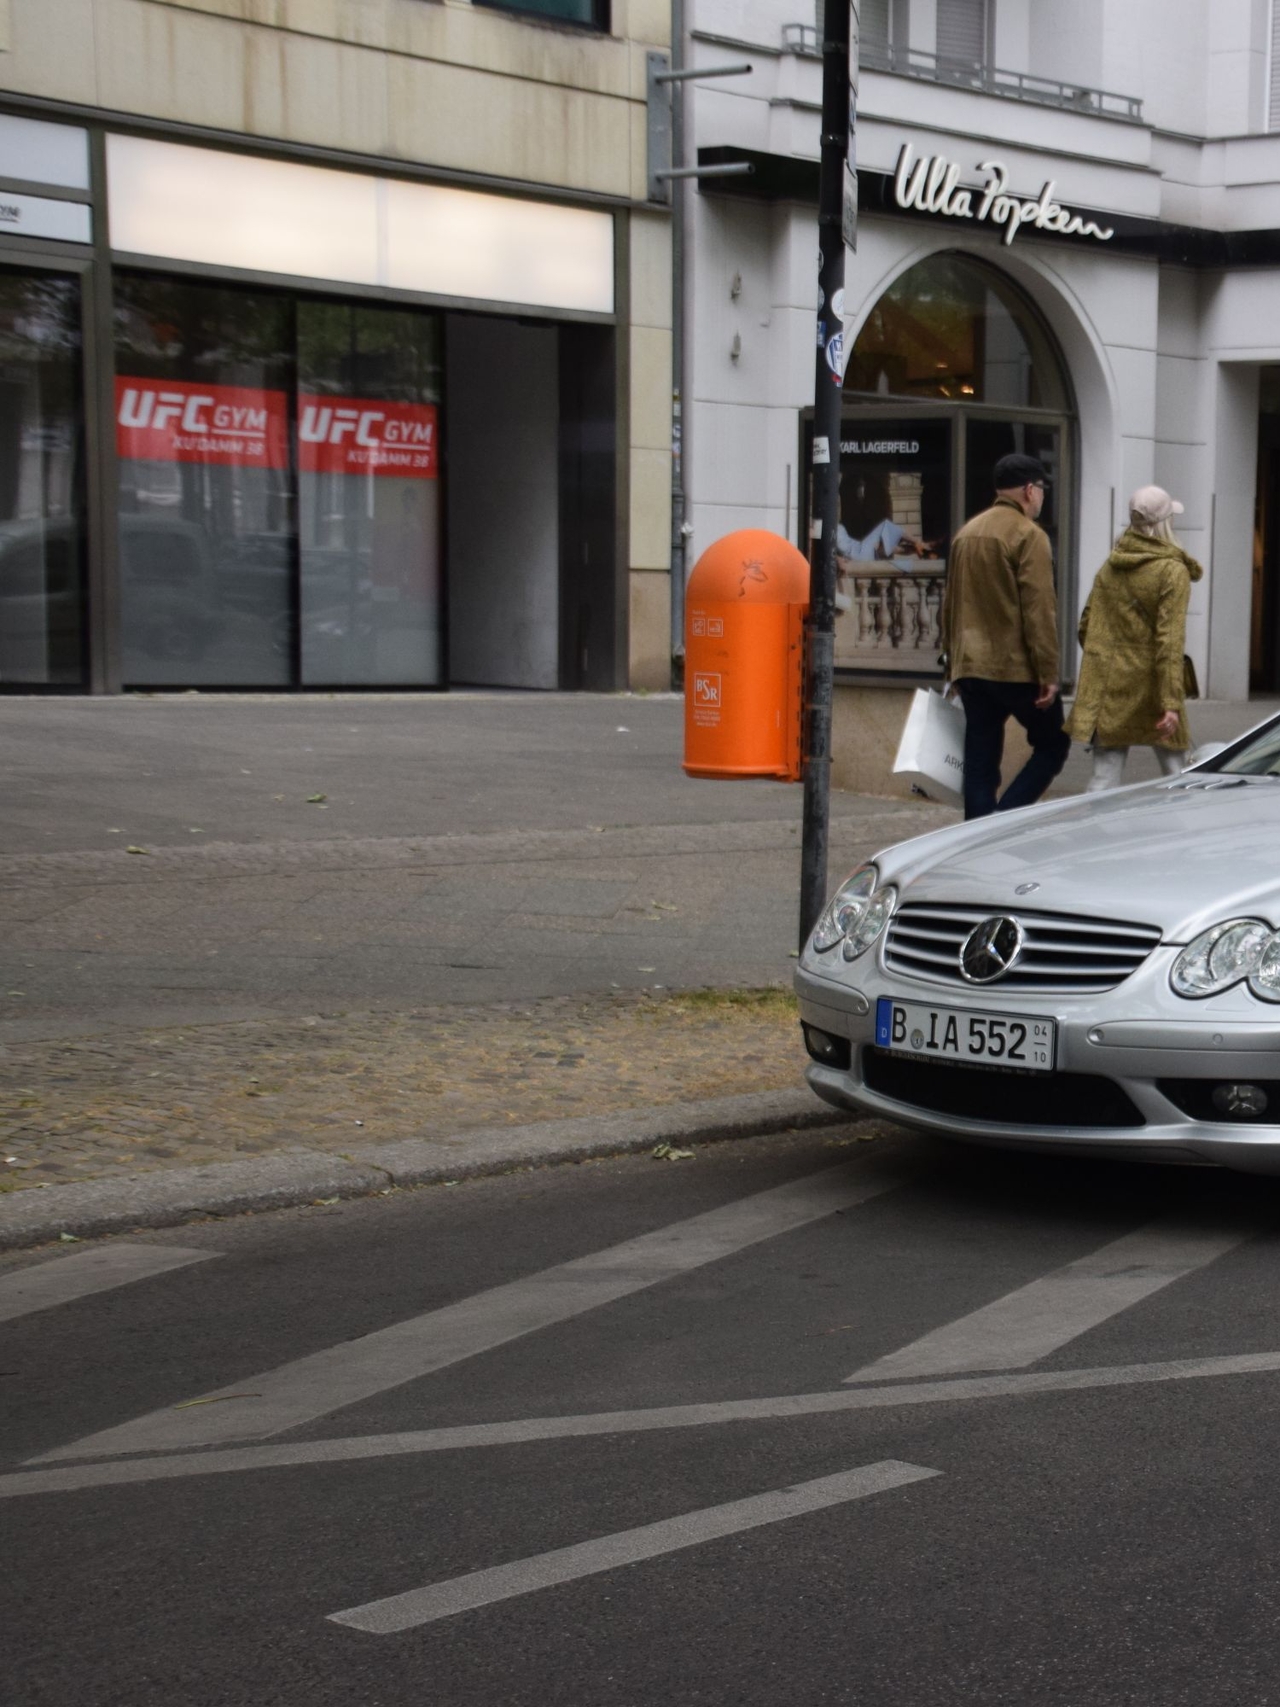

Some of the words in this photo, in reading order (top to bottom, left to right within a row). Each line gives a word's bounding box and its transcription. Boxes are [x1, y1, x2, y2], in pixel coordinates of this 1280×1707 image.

[896, 143, 973, 218] Ulla
[976, 160, 1114, 246] Popken
[118, 389, 214, 433] UFC
[214, 405, 268, 431] GYM
[298, 406, 385, 448] UFC
[384, 420, 433, 443] GYM
[862, 441, 919, 454] LAGERFELD
[697, 679, 718, 700] BSR
[881, 1028, 888, 1038] D
[892, 1007, 906, 1043] B
[926, 1012, 959, 1052] IA
[968, 1017, 1026, 1060] 552
[1034, 1024, 1047, 1036] 04
[1034, 1051, 1047, 1063] 10
